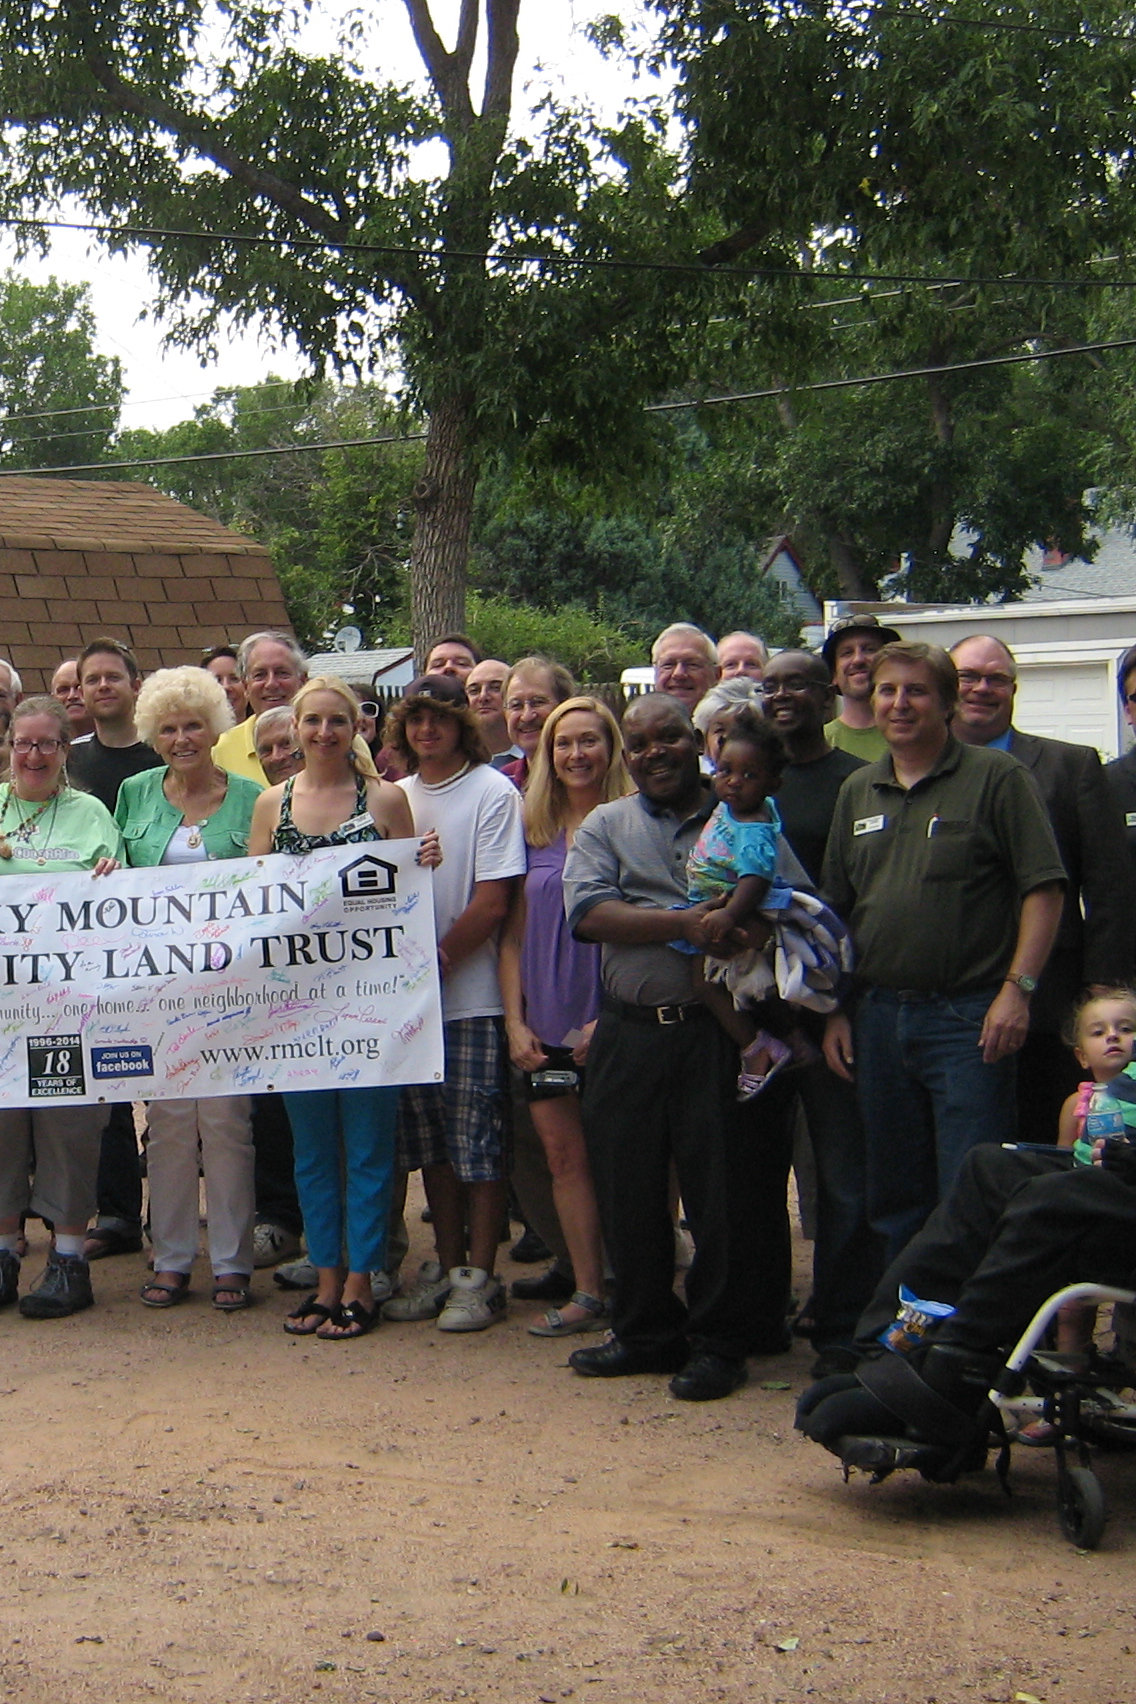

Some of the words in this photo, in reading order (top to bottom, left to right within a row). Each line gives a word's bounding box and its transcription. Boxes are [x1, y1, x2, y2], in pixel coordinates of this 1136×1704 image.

[55, 880, 309, 933] MOUNTAIN
[367, 896, 396, 905] HOUSING
[343, 903, 397, 914] OPPORTUNITY
[102, 940, 233, 980] LAND
[249, 925, 405, 969] TRUST
[63, 1002, 88, 1016] one
[158, 997, 186, 1011] one
[193, 980, 299, 1014] neighborhood
[309, 983, 327, 1000] at
[336, 985, 347, 998] a
[101, 1052, 118, 1060] JOIN
[119, 1051, 130, 1059] US
[131, 1050, 142, 1058] ON
[200, 1035, 381, 1064] www.rmclt.org
[42, 1049, 71, 1075] 18
[96, 1059, 150, 1073] facebook
[37, 1079, 64, 1087] YEARS
[66, 1078, 77, 1086] OF
[31, 1086, 83, 1096] EXCELLENCE
